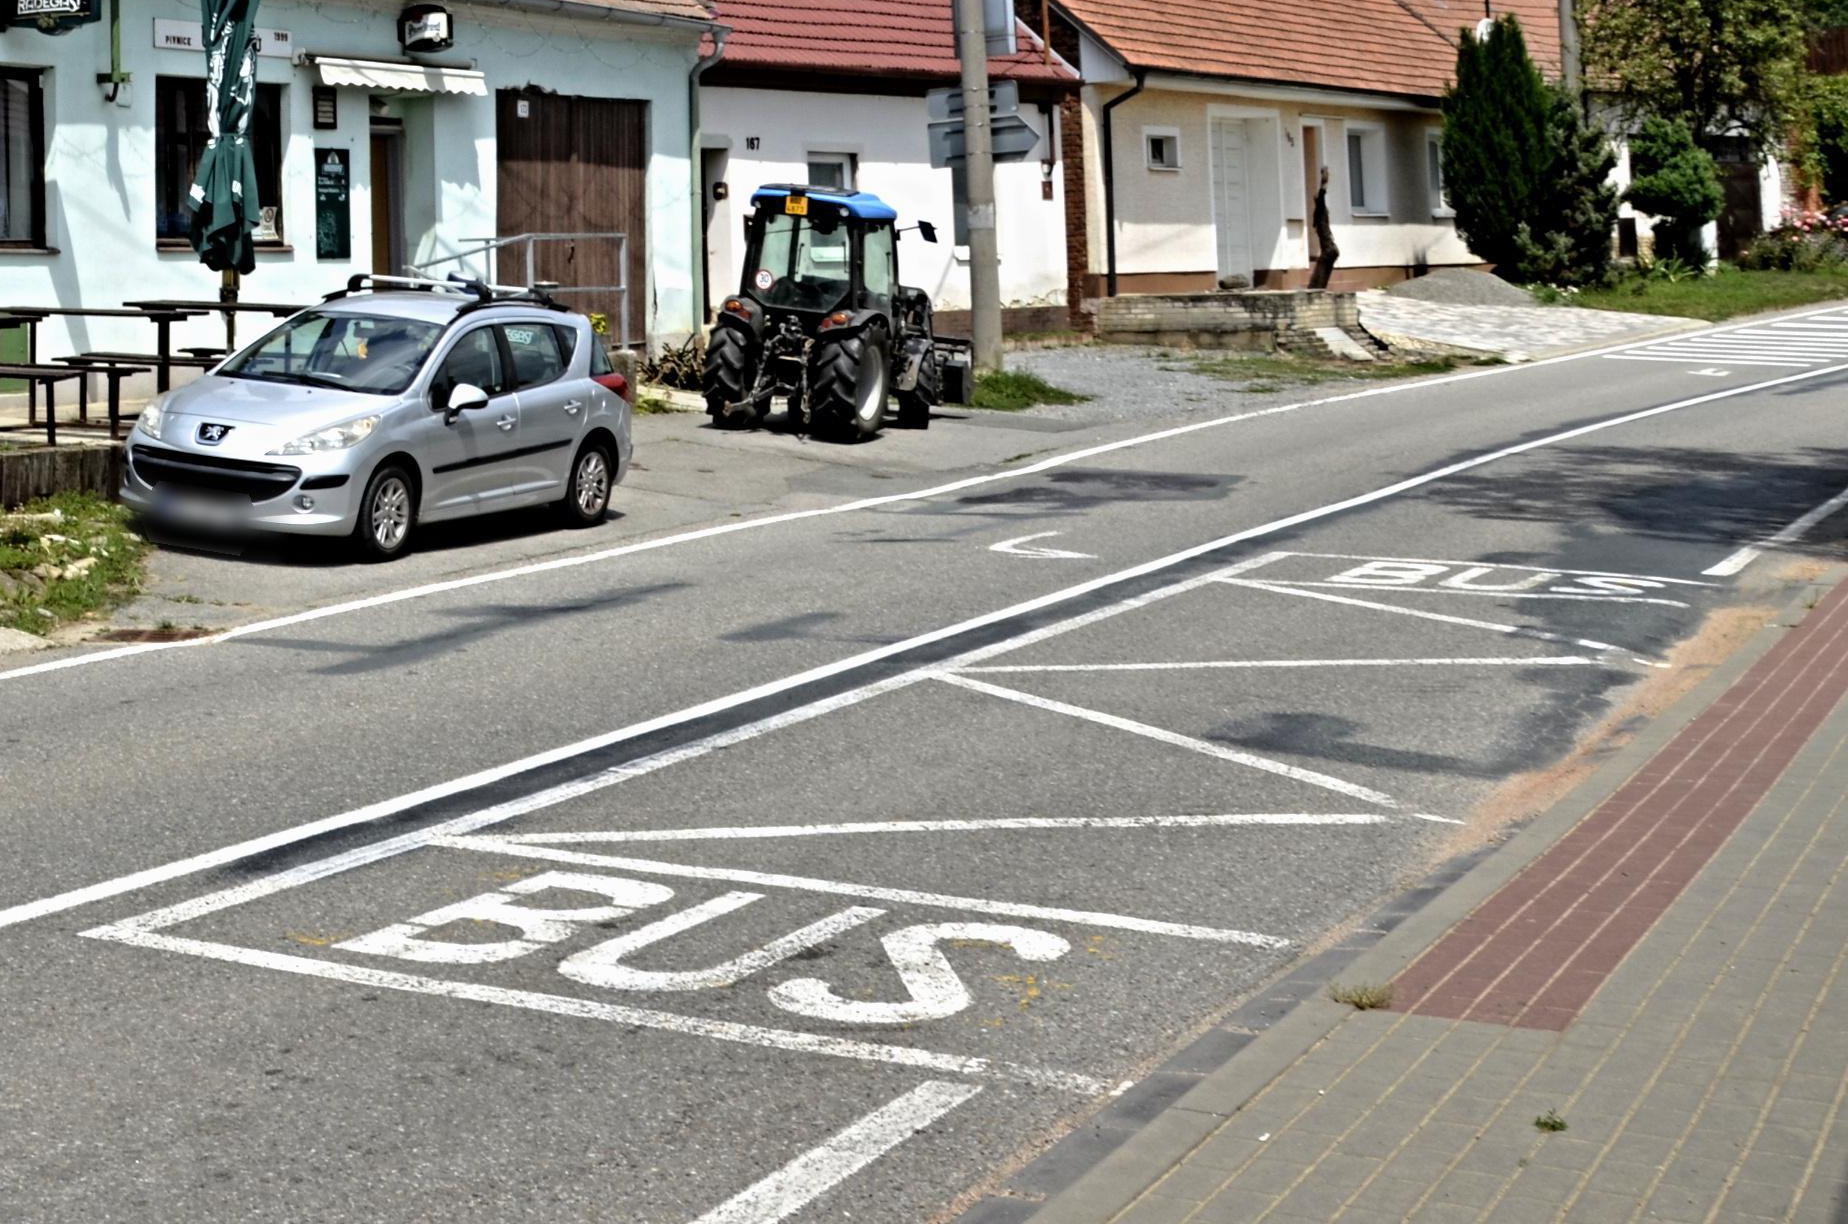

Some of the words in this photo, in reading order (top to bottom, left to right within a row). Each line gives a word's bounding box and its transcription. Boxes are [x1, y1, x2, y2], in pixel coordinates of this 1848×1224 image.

[165, 35, 191, 47] PIVNICE
[746, 137, 760, 151] 167
[760, 273, 770, 282] 30
[1325, 561, 1667, 596] BUS
[331, 871, 1072, 1024] BUS
